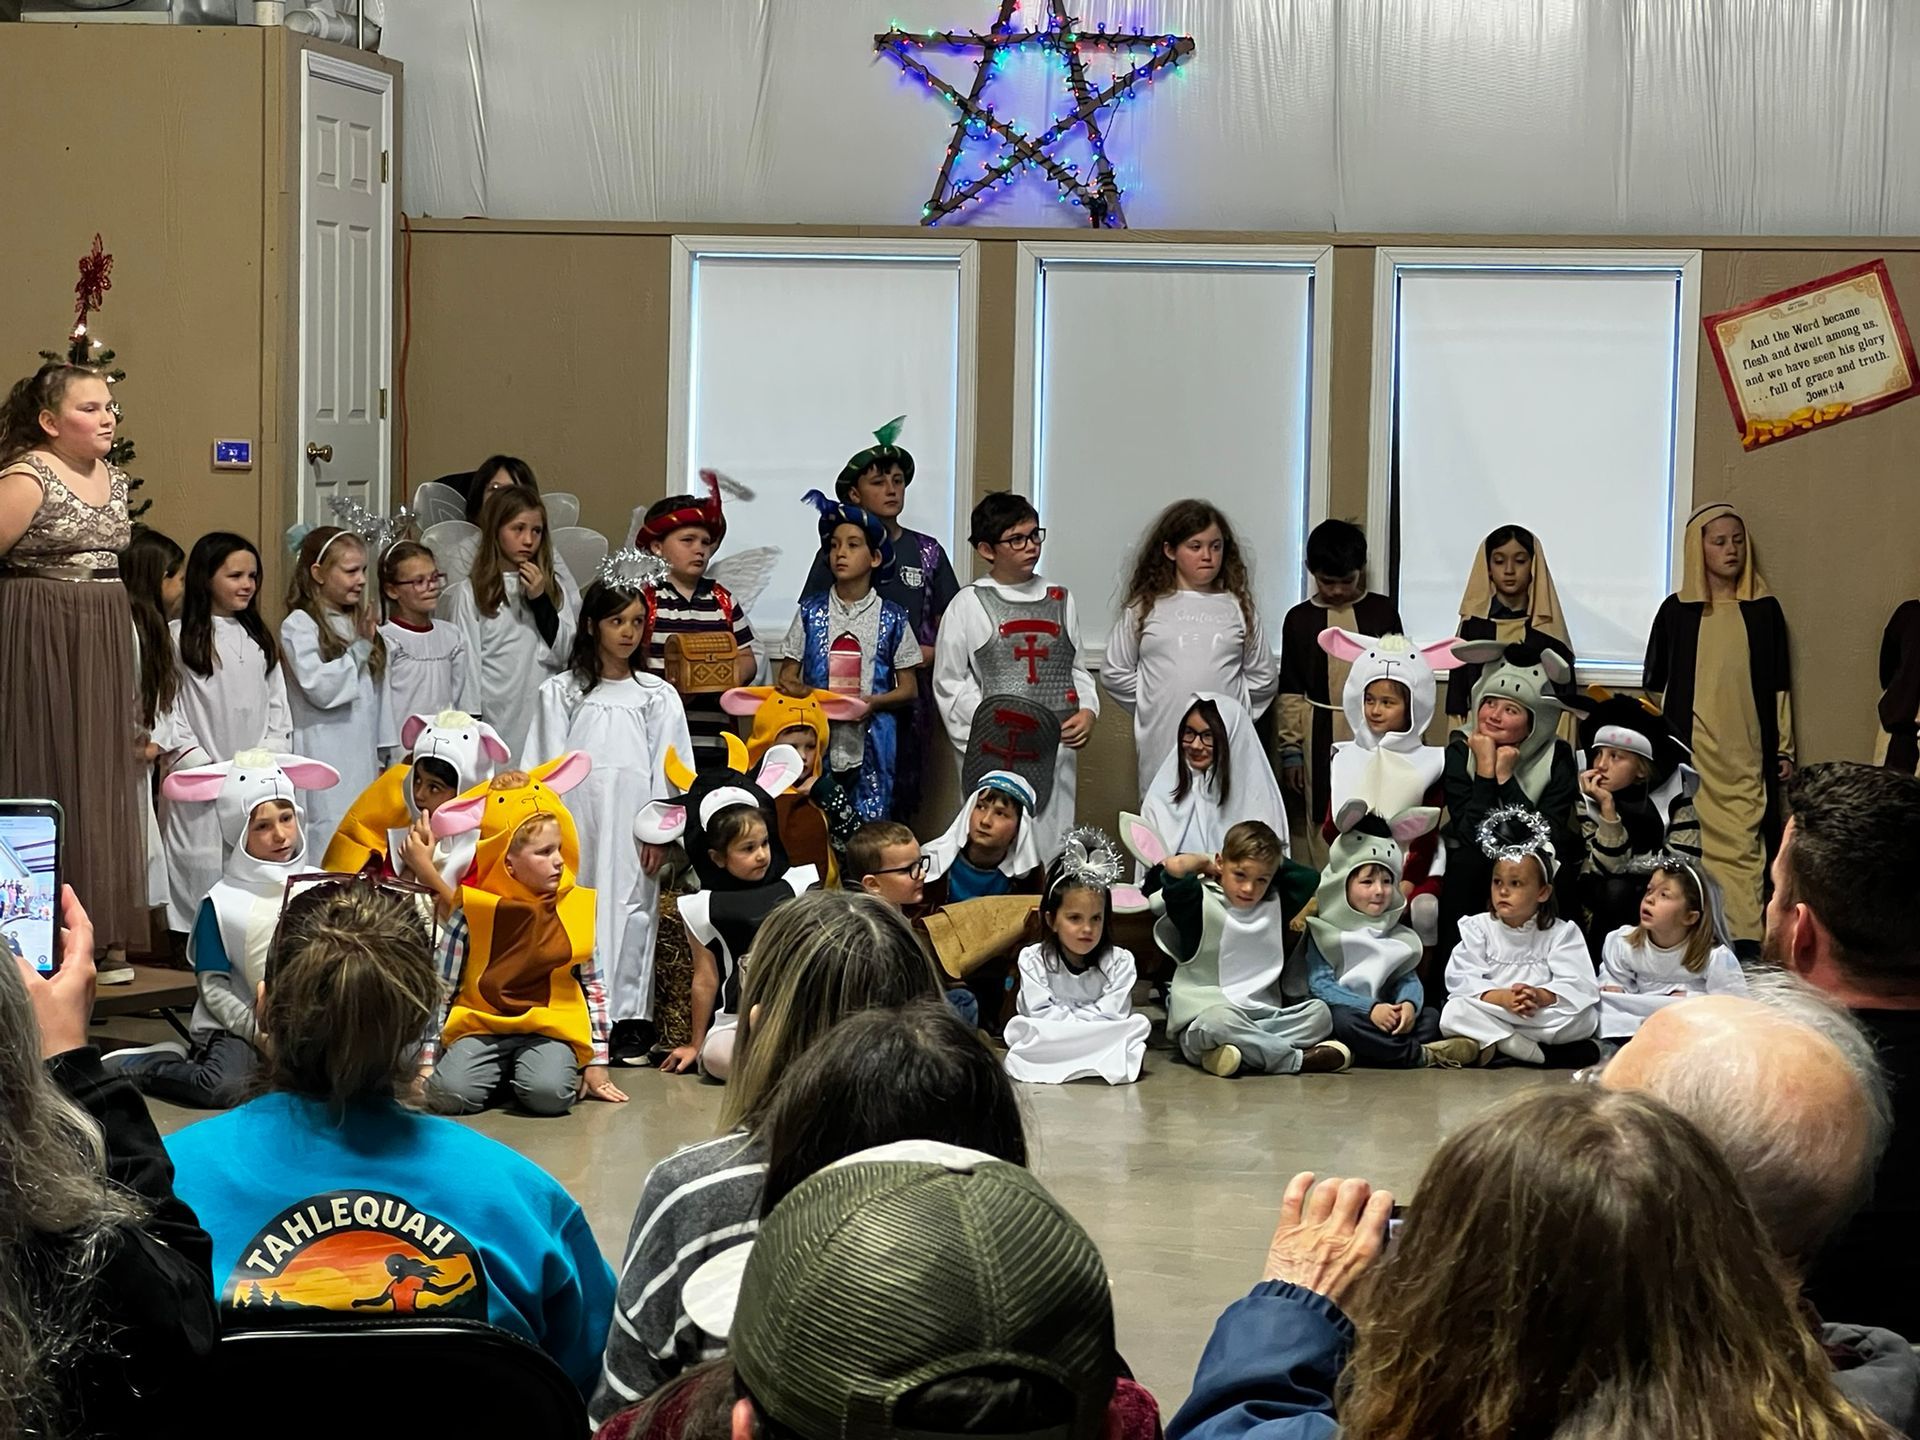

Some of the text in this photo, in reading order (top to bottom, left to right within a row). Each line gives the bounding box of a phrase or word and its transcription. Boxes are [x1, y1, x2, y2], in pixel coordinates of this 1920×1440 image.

[1743, 320, 1878, 370] flesh and dwelt among us.
[1750, 307, 1860, 350] And the Word became
[1745, 334, 1885, 387] and we have seen his glory
[1791, 377, 1801, 389] of
[1805, 369, 1834, 388] grace
[1836, 360, 1856, 375] and
[1858, 350, 1890, 368] truth.
[1830, 381, 1845, 394] 1:14
[246, 1195, 456, 1274] TAHLEQUAH
